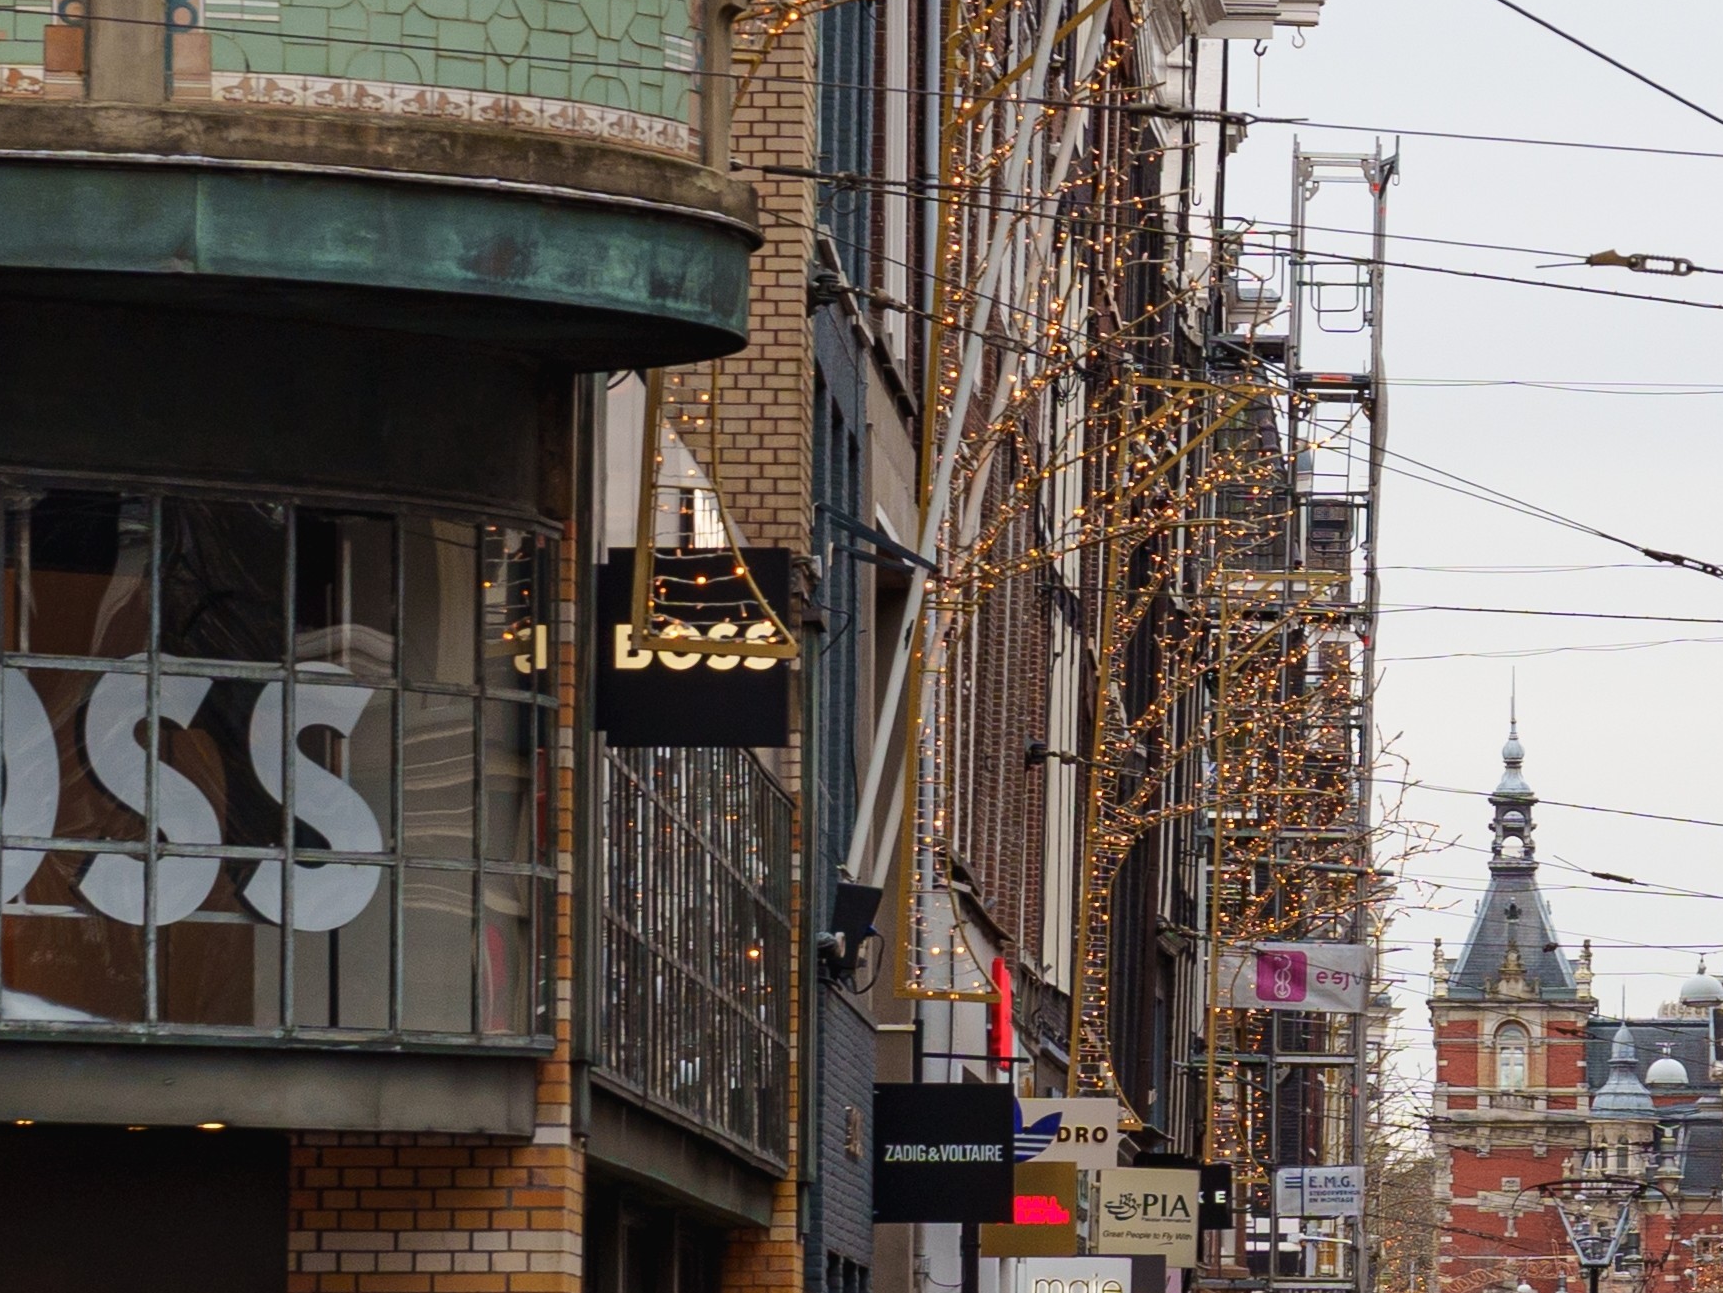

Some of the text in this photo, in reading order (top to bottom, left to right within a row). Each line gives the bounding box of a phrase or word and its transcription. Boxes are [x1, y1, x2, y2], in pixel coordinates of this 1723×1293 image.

[614, 621, 778, 671] BOSS
[884, 1144, 1003, 1162] ZADIG&VOLTAIRE
[1142, 1193, 1190, 1218] PIA
[1102, 1230, 1124, 1238] Great
[1125, 1231, 1151, 1240] People
